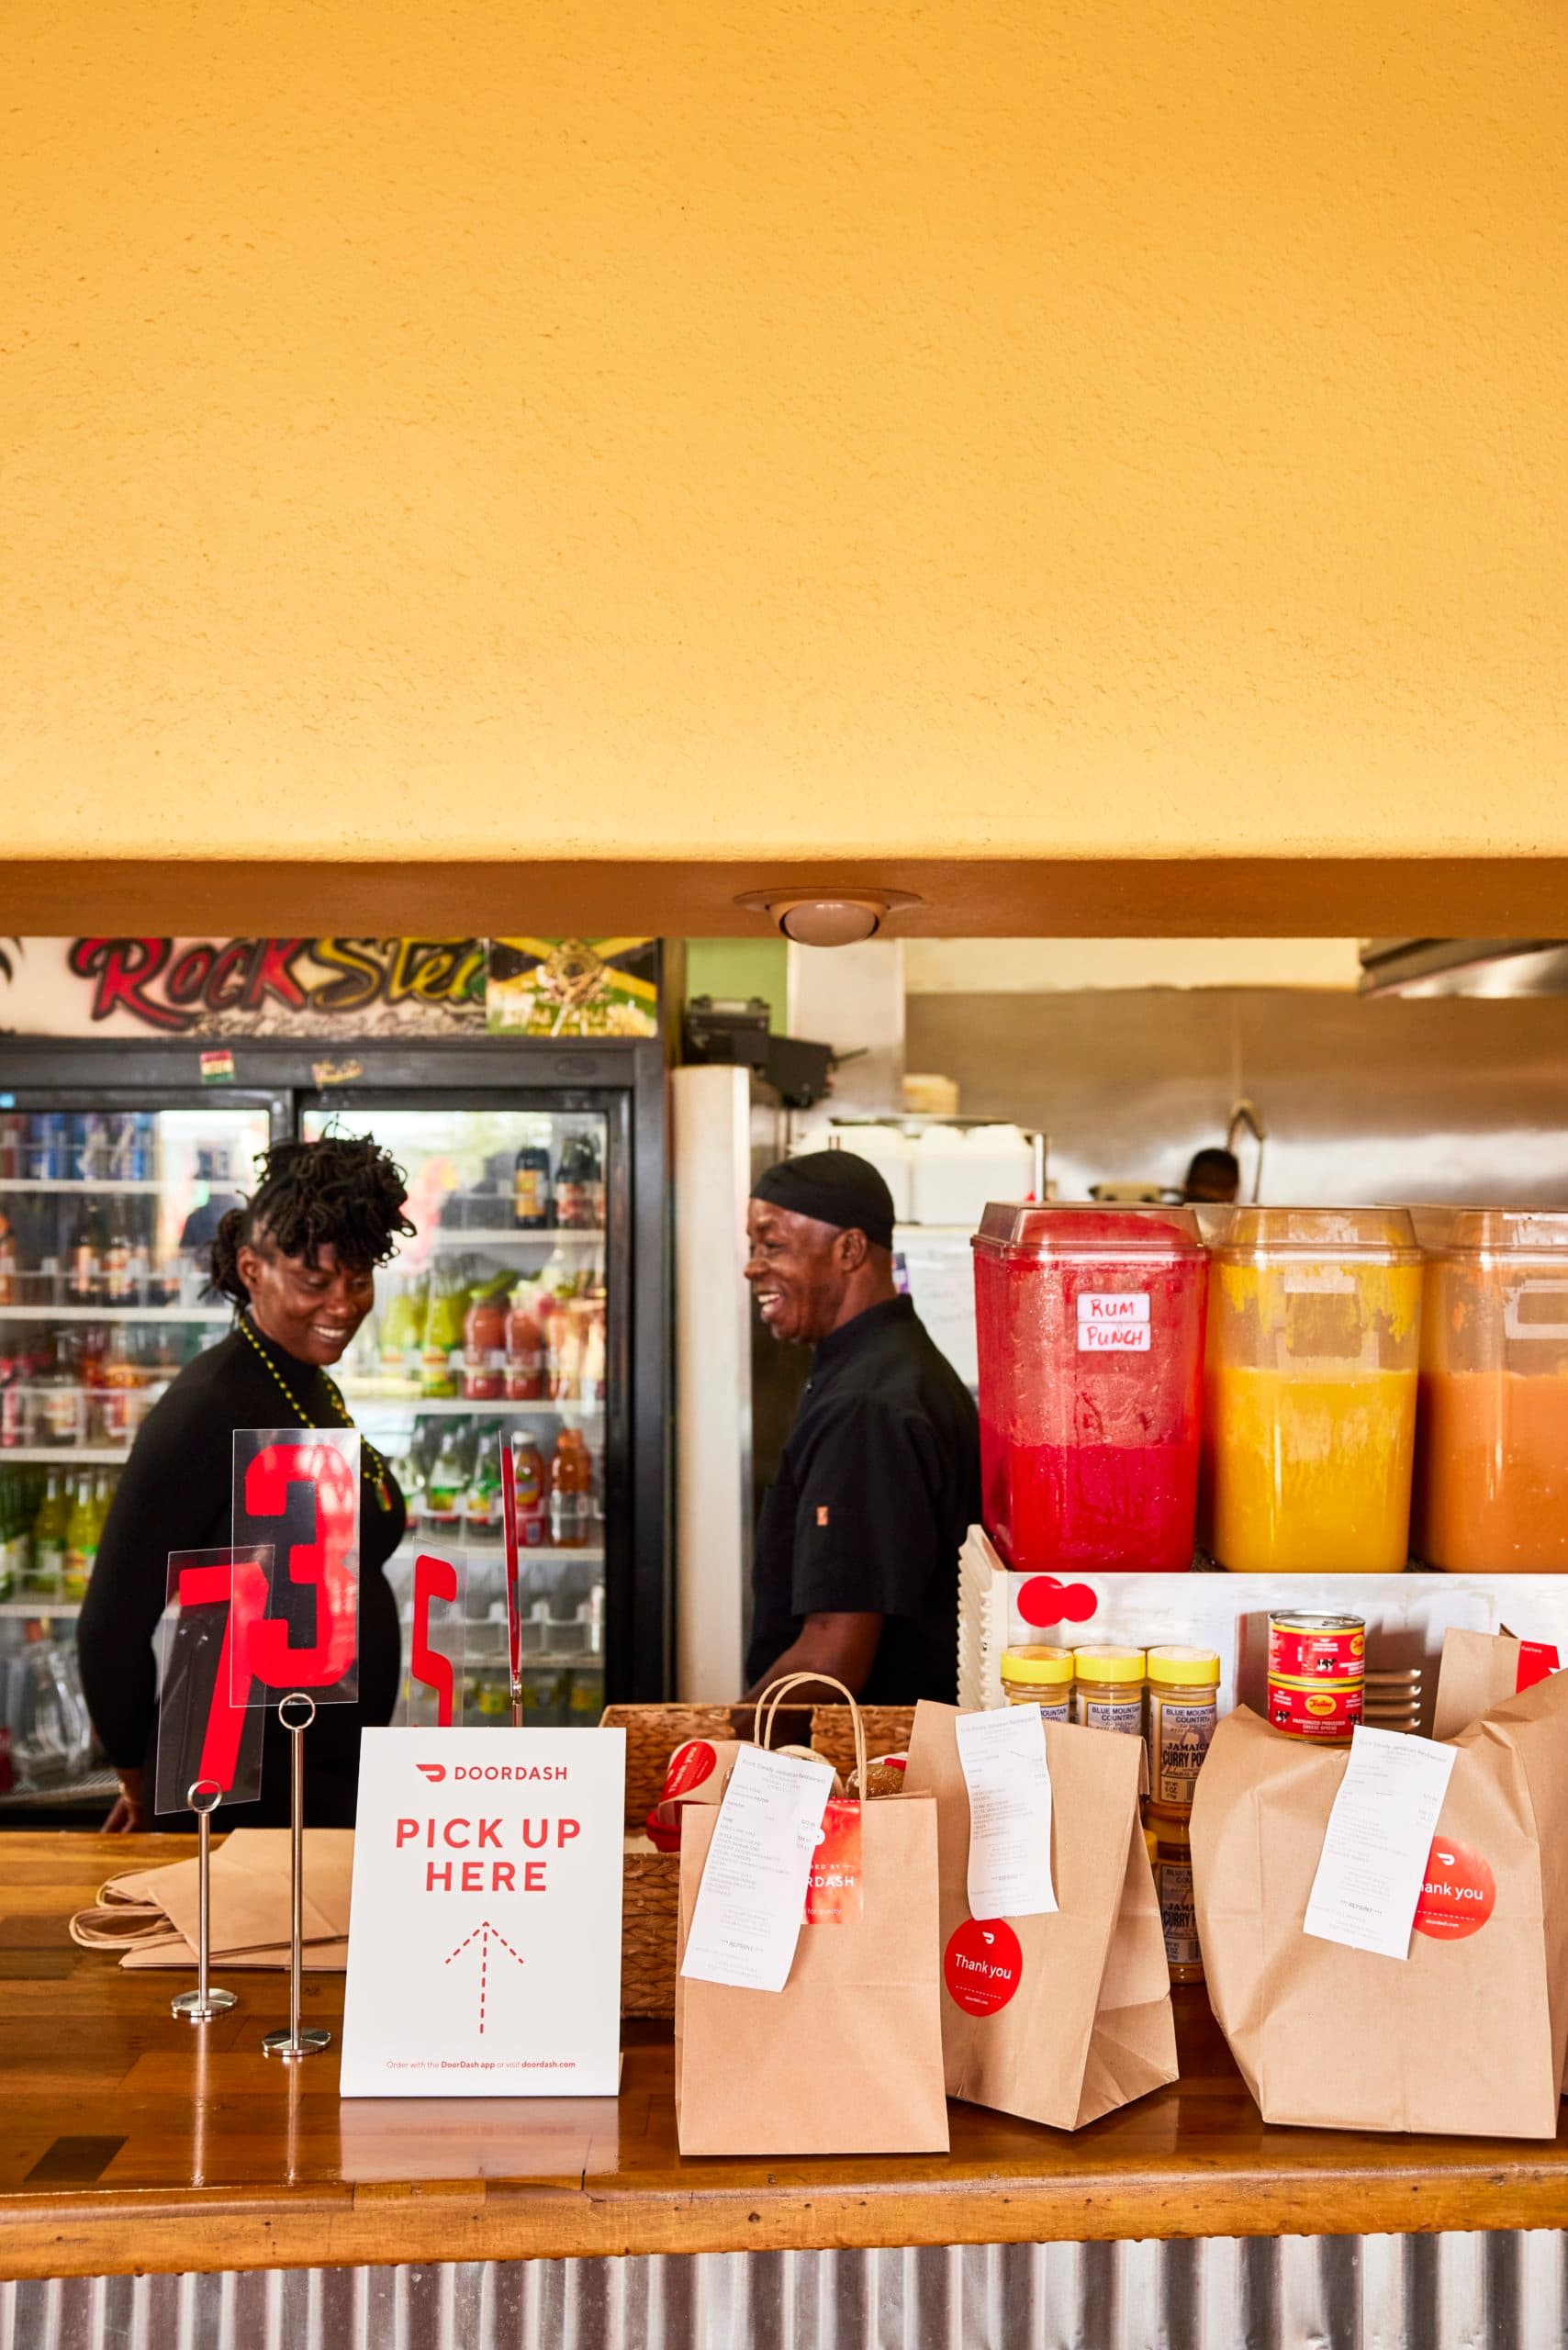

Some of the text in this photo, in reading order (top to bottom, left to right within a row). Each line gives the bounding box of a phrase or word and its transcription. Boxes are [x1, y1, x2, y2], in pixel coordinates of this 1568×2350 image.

[1091, 1298, 1135, 1317] RUM
[1087, 1326, 1143, 1347] PUNCH
[245, 1444, 355, 1688] 3
[411, 1554, 457, 1728] 5
[179, 1562, 269, 1794] 7
[1092, 1706, 1111, 1714] BLUE
[1166, 1708, 1185, 1717] BLUE
[1167, 1742, 1209, 1751] JAMAIC
[1162, 1750, 1190, 1768] CURRY
[454, 1766, 568, 1781] DOORDASH
[396, 1818, 581, 1849] PICK UP
[425, 1861, 547, 1892] HERE
[808, 1875, 855, 1888] RDASH
[1420, 1881, 1484, 1901] ank you
[1163, 1911, 1191, 1927] CURRY
[955, 1953, 1012, 1980] Thank you
[386, 2060, 409, 2069] Order
[410, 2060, 426, 2069] with
[427, 2060, 440, 2069] the
[441, 2060, 479, 2068] DoorDash
[480, 2062, 496, 2070] app
[521, 2060, 577, 2068] doordash.com
